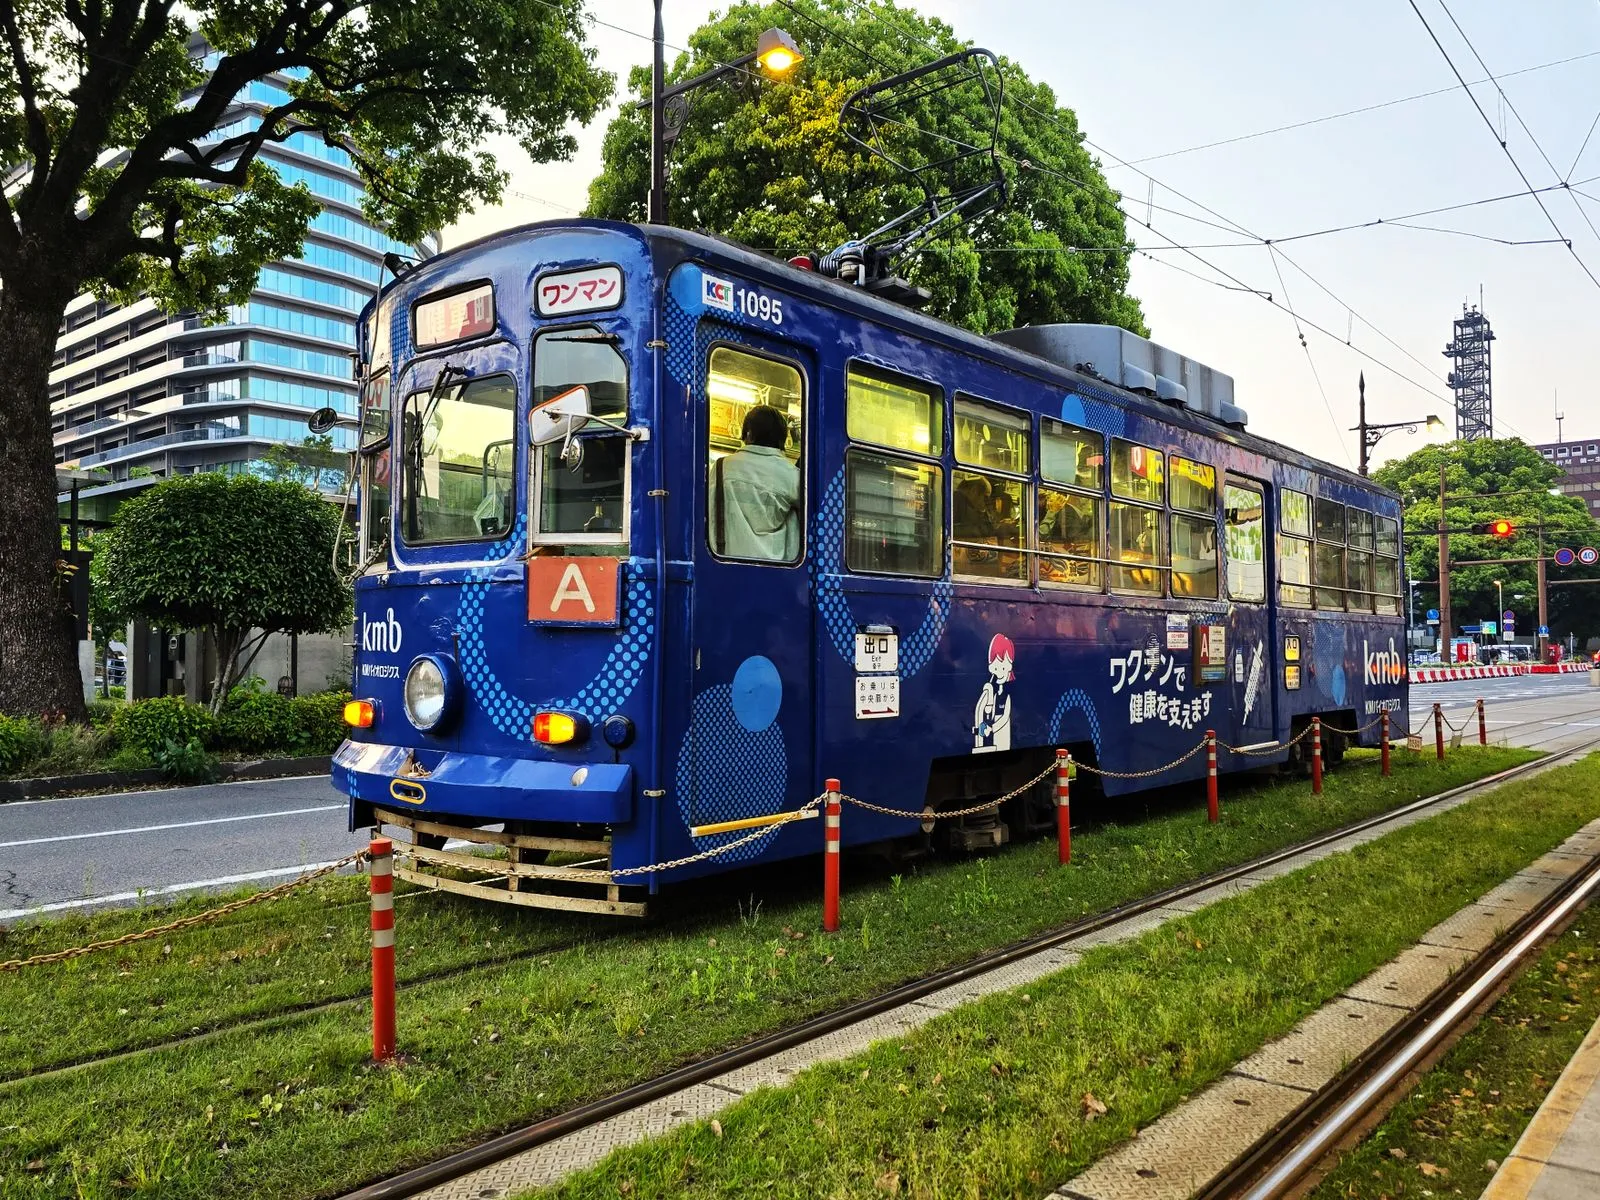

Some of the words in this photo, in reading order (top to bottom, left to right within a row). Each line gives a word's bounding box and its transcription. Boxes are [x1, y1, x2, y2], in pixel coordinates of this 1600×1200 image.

[542, 278, 616, 306] ワンマン
[706, 280, 731, 302] KCT
[737, 288, 783, 325] 1095
[550, 563, 596, 613] A
[362, 607, 402, 653] kmb
[865, 637, 888, 654] 出口
[1200, 633, 1209, 658] A
[1110, 649, 1186, 694] ワクチンで
[1364, 637, 1401, 685] kmb
[1130, 690, 1213, 730] 健康を支えます
